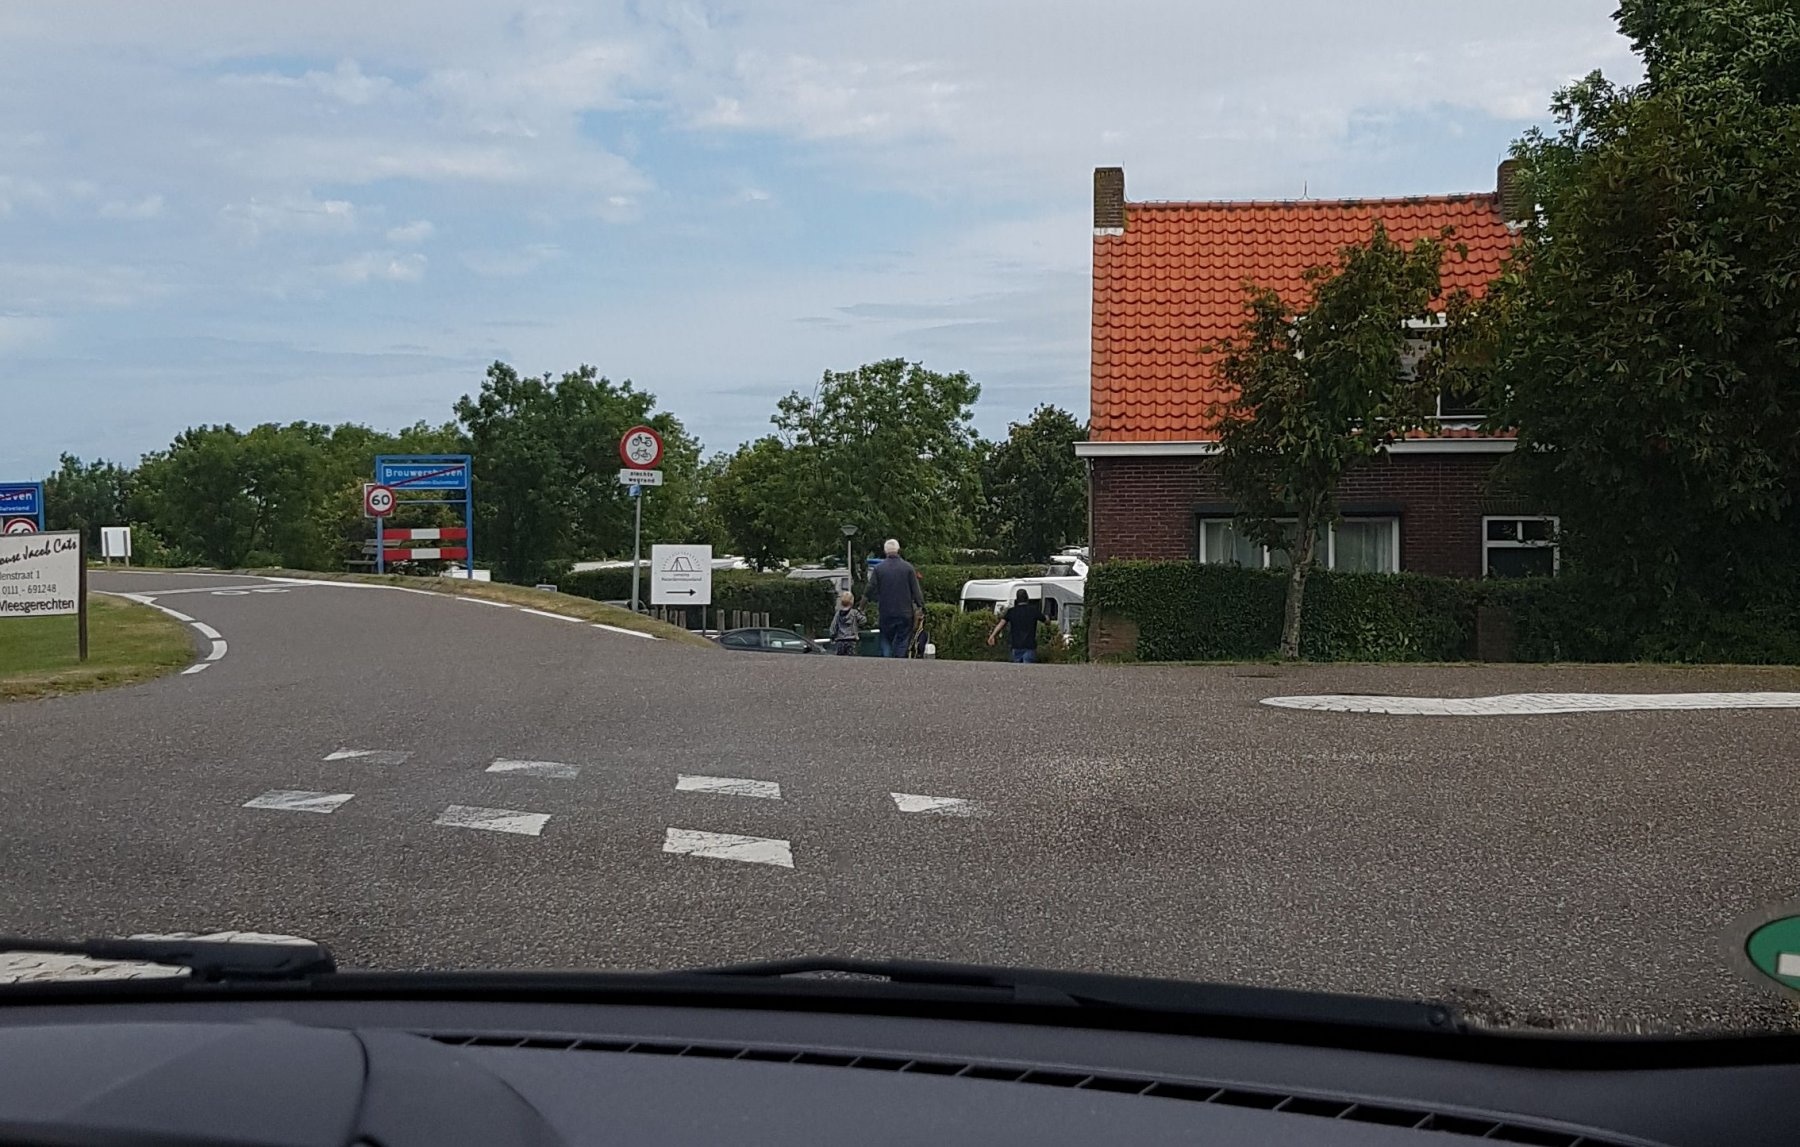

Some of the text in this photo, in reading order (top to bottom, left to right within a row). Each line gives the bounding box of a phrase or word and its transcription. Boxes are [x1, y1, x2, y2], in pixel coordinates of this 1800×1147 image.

[371, 494, 391, 506] 60
[22, 540, 52, 560] Jacob
[53, 538, 77, 553] Cats
[2, 585, 19, 595] 0111
[27, 584, 57, 594] 691248
